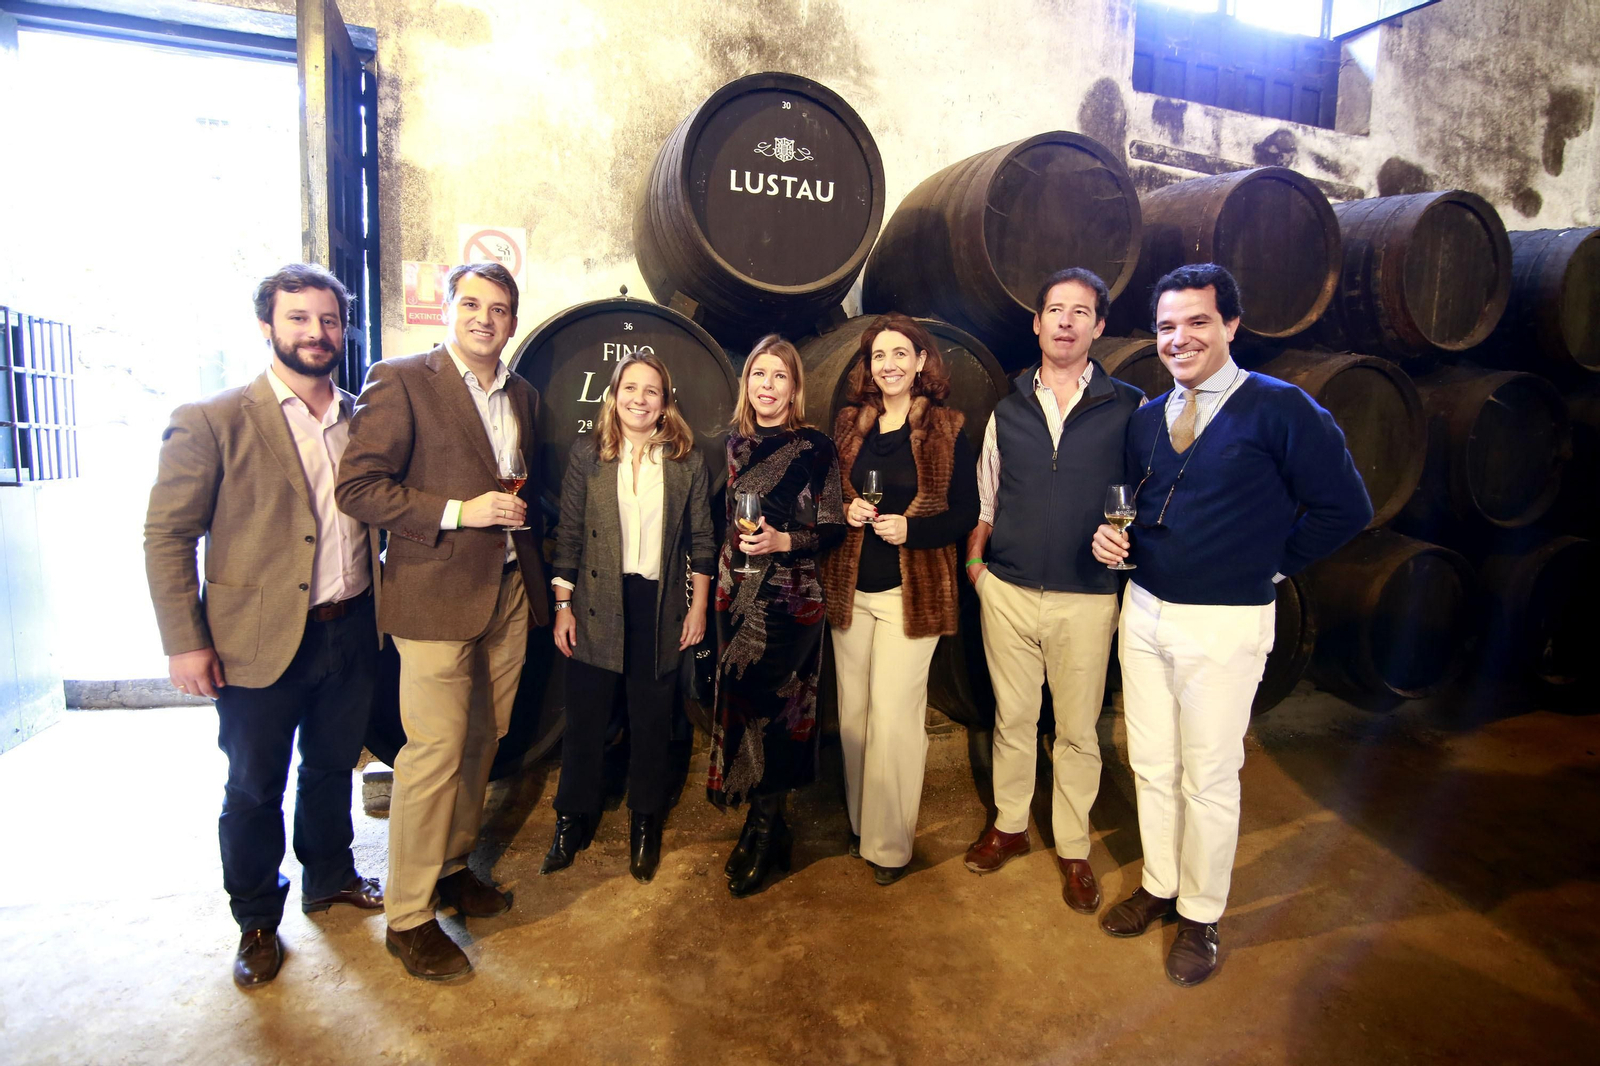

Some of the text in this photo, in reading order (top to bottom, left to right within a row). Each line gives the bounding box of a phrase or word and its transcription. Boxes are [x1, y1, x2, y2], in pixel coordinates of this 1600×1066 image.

[782, 101, 791, 110] 30
[730, 169, 835, 202] LUSTAU
[409, 312, 443, 321] EXTINTO
[623, 322, 633, 331] 36
